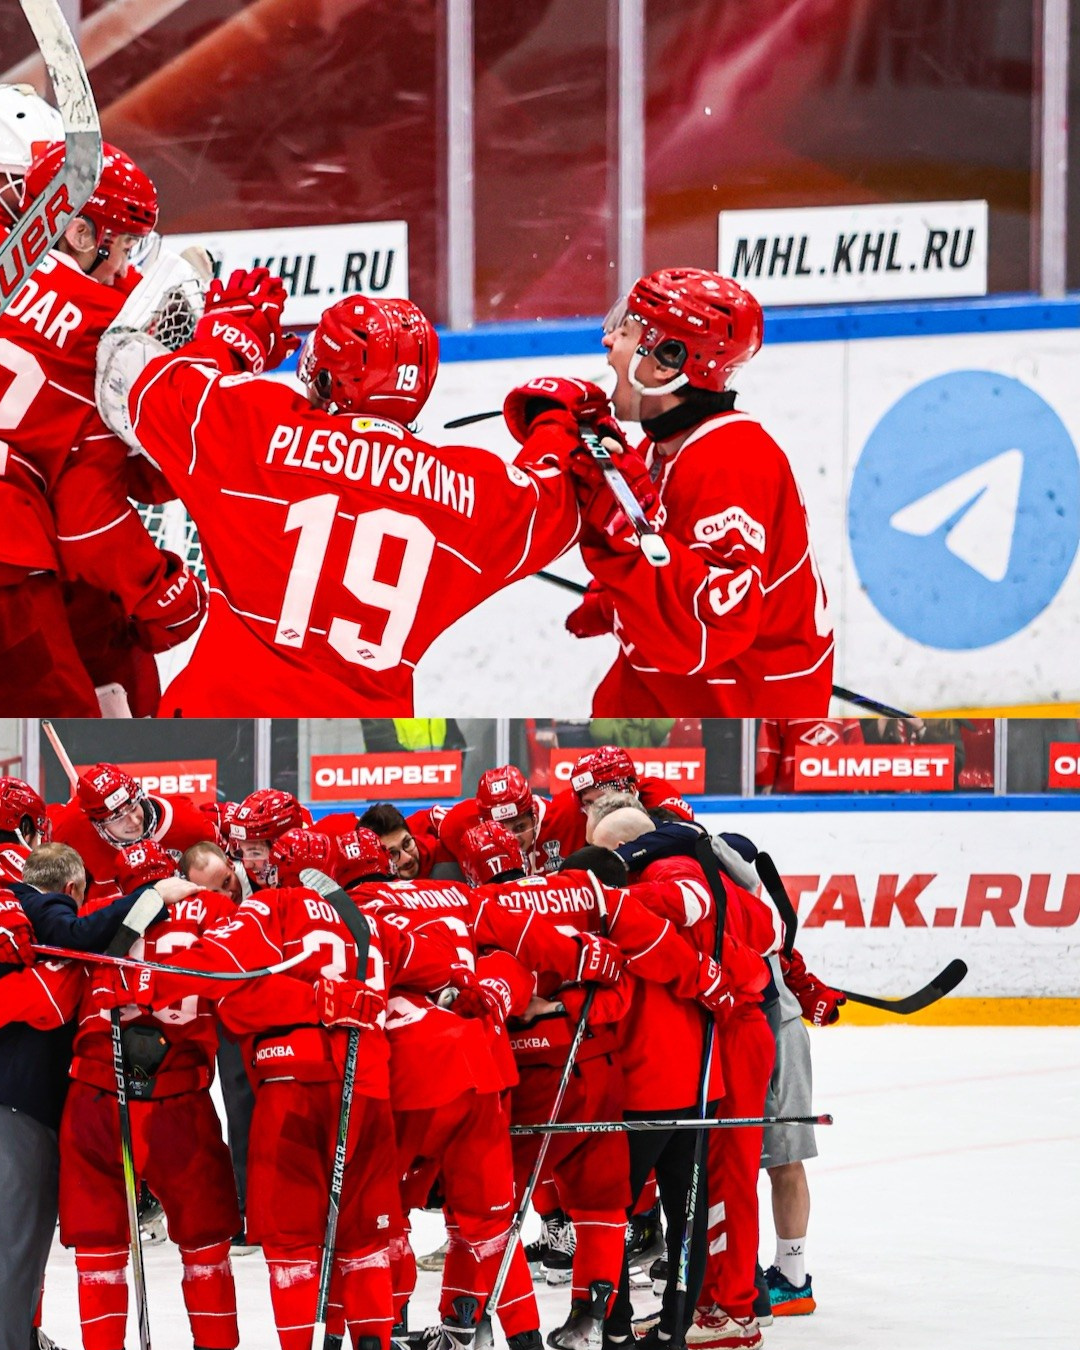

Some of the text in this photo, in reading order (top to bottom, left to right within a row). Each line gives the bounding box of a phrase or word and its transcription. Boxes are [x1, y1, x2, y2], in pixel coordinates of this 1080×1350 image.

[731, 227, 975, 279] MHL.KHL.RU
[396, 364, 419, 392] 19
[265, 425, 475, 518] PLESOVSKIKH
[274, 493, 436, 672] 19
[315, 764, 457, 787] OLIMPBET
[800, 755, 951, 780] OLIMPBET
[486, 857, 503, 875] 17
[331, 1145, 347, 1194] REKKER
